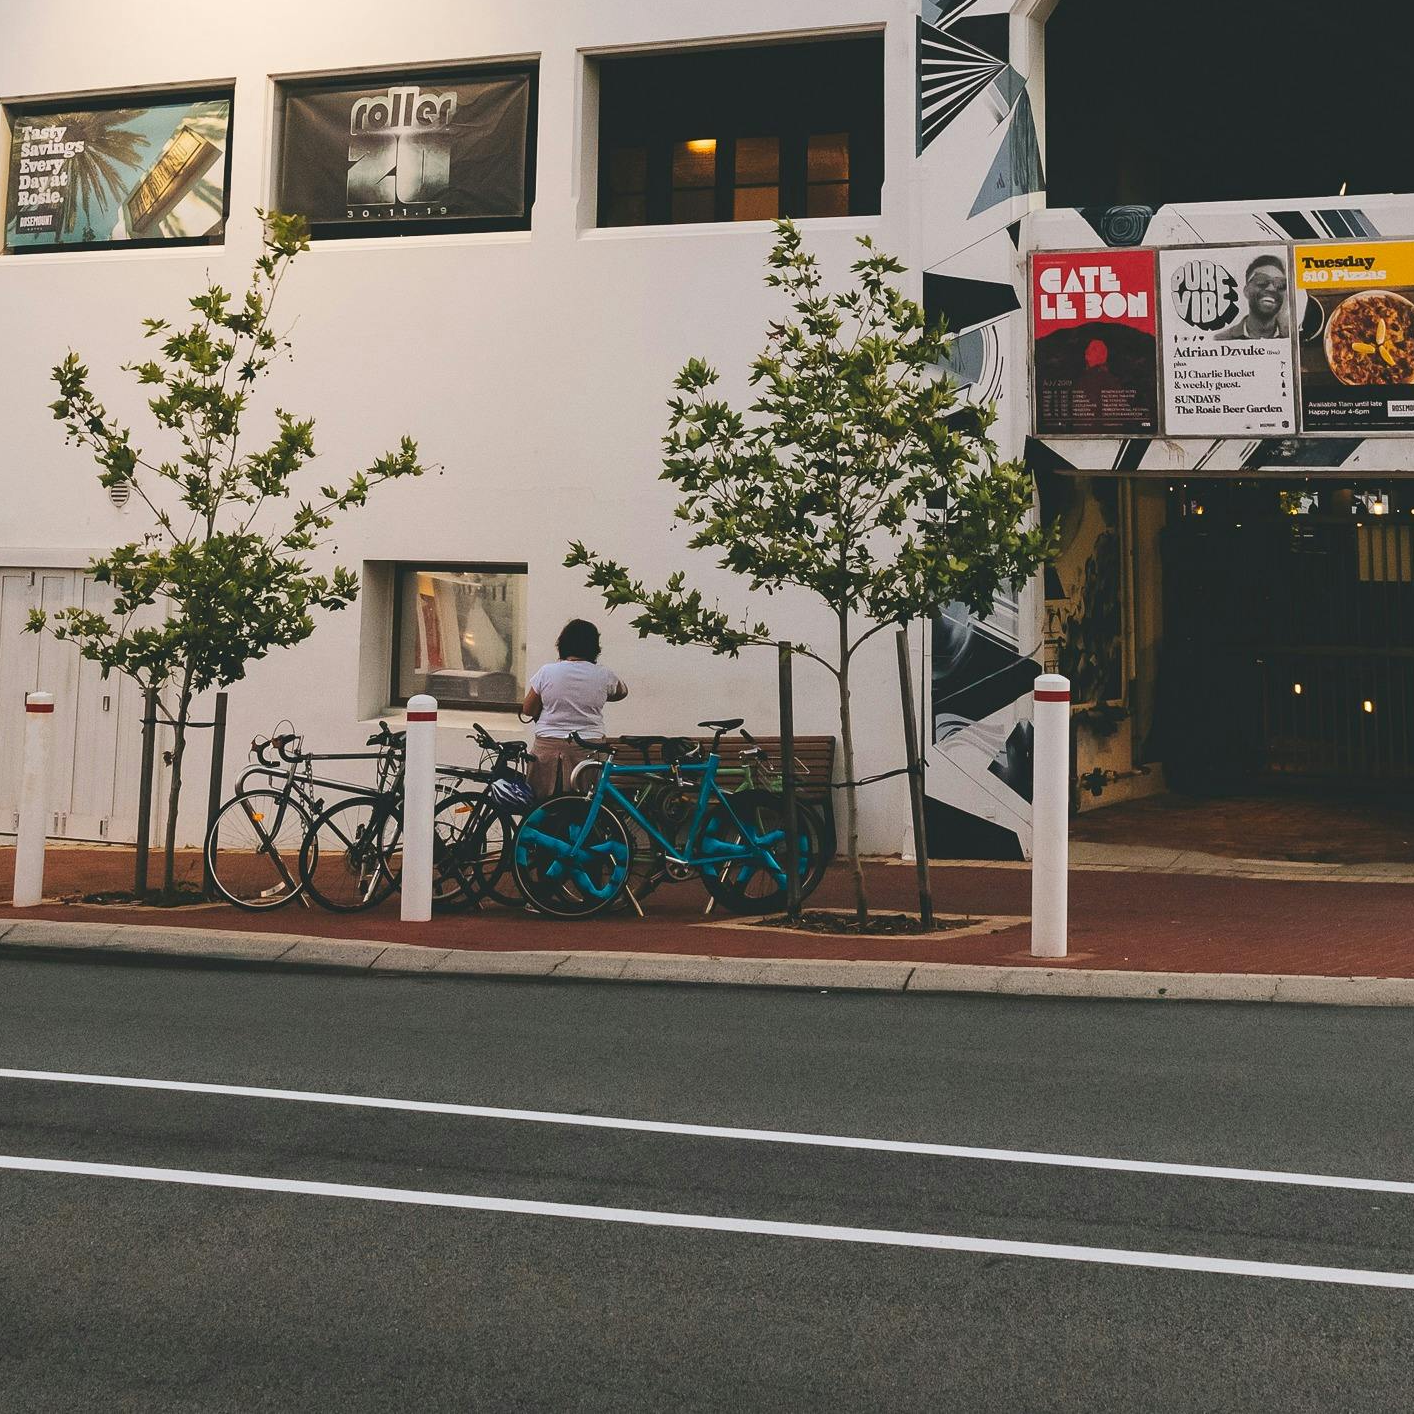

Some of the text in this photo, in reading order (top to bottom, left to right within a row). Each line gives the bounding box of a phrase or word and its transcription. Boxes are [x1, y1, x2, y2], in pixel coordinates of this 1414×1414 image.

[353, 88, 456, 133] roller
[22, 125, 67, 142] Tasty
[21, 140, 85, 158] Savings
[19, 158, 65, 174] Every
[18, 172, 68, 193] Day at
[18, 189, 64, 206] Rosie.
[1302, 255, 1376, 270] Tuesday
[1039, 266, 1121, 294] CATE
[1171, 260, 1232, 294] PURE
[1302, 268, 1387, 282] $10 Pizzas
[1040, 291, 1148, 320] LE BON
[1171, 287, 1236, 326] VIBE
[1173, 346, 1218, 358] Adrian
[1221, 345, 1266, 357] Dzvuke
[1174, 369, 1256, 379] DJ Charlie Bucket
[1174, 381, 1181, 389] &
[1182, 381, 1214, 391] weekly
[1174, 394, 1221, 404] SUNDAYS
[1175, 404, 1283, 415] The Rosie Beer Garden
